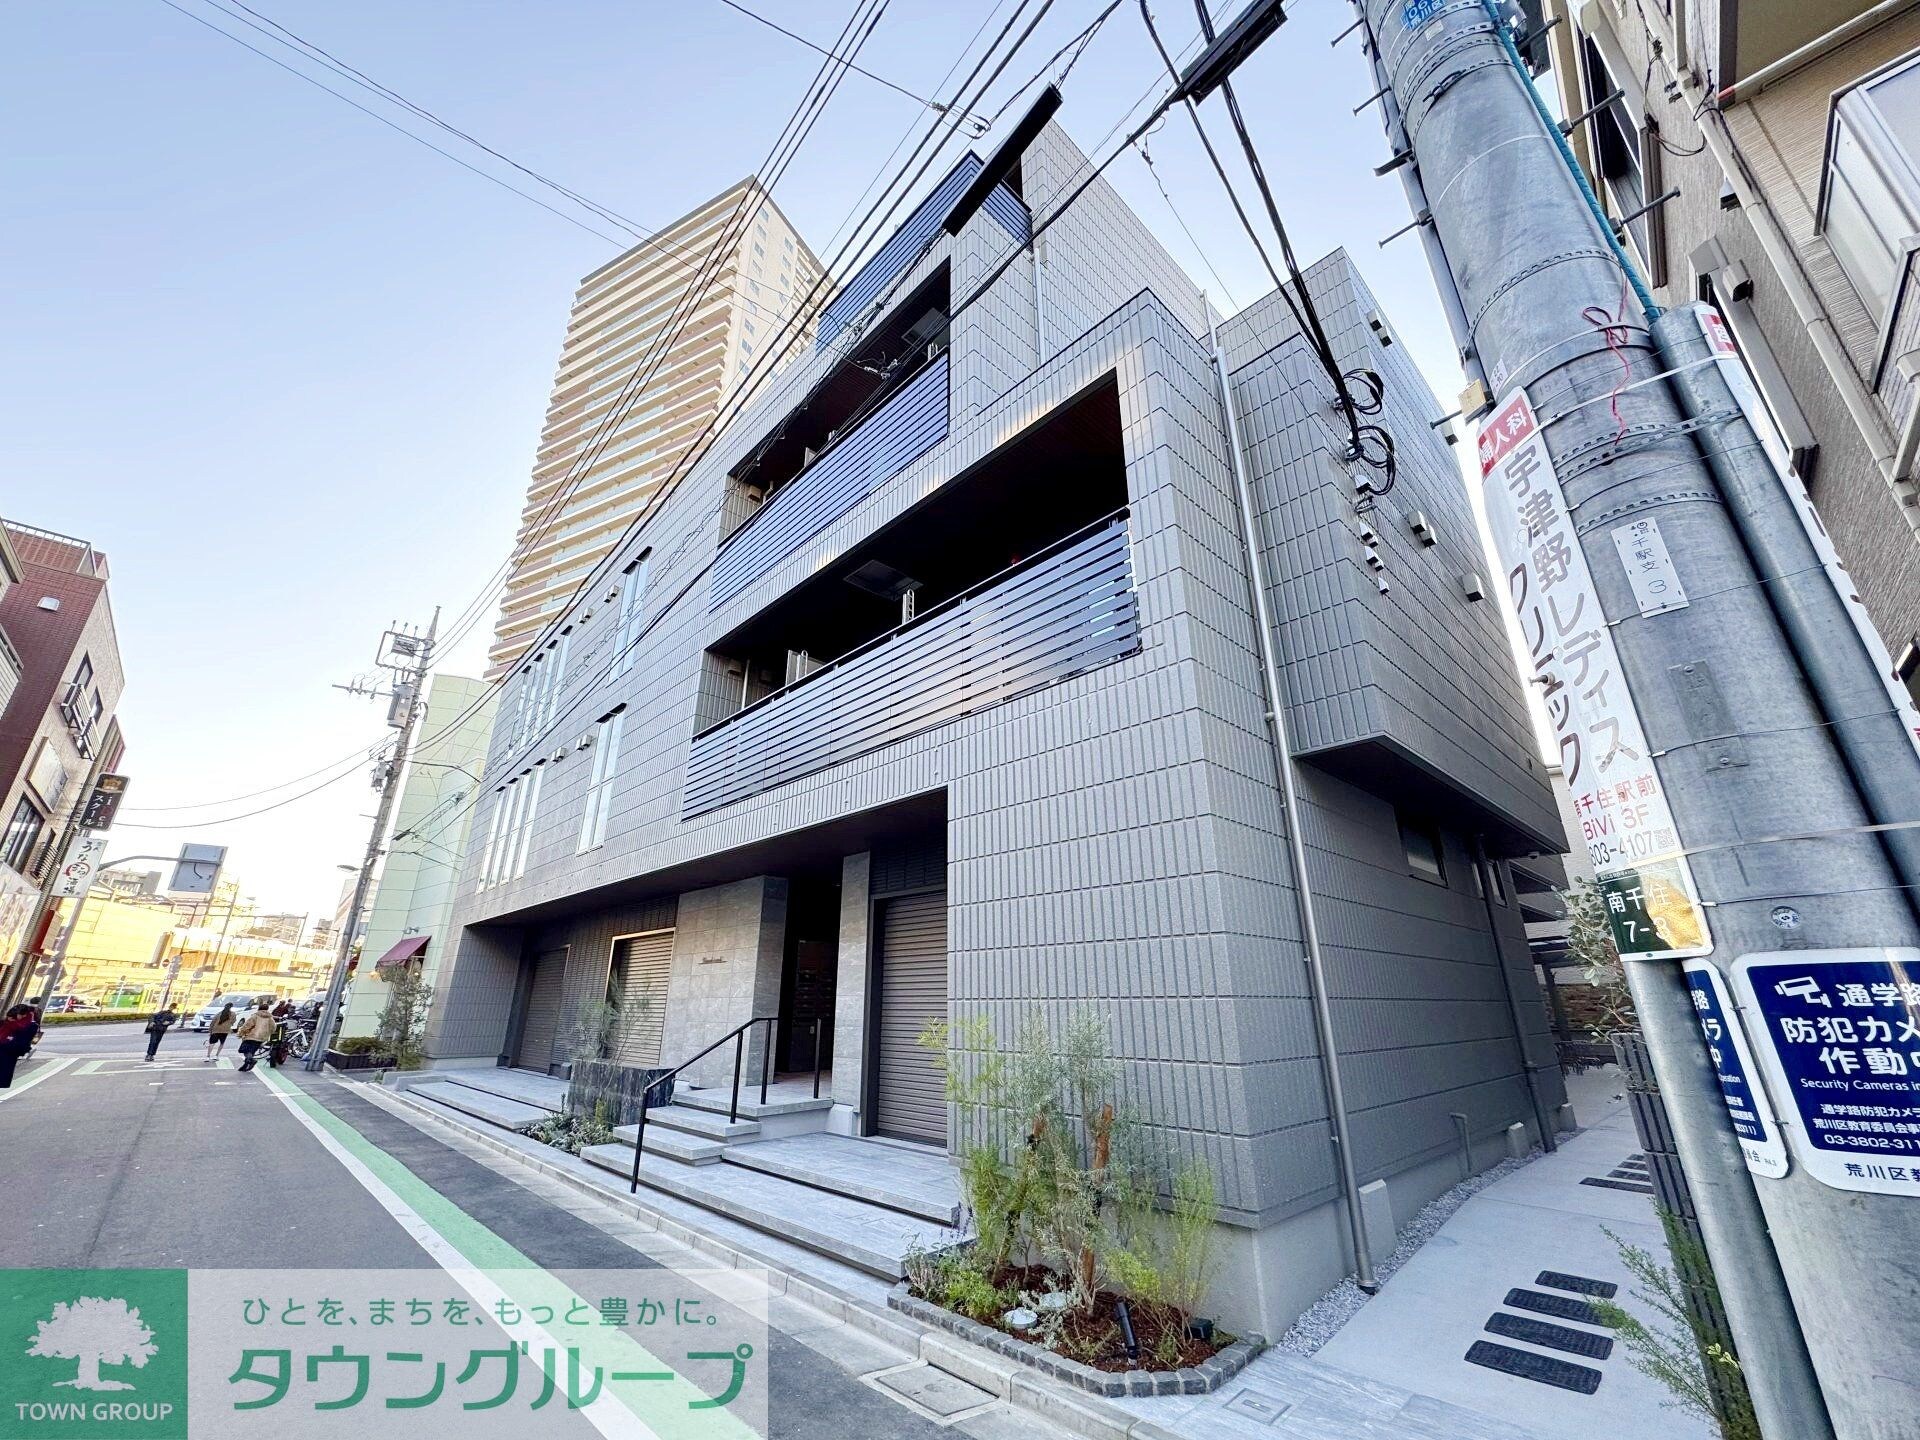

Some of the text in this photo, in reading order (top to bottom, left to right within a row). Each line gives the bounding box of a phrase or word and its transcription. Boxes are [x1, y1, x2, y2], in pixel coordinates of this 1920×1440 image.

[1504, 445, 1640, 774] 宇津野レディス
[1510, 562, 1582, 787] クリニック
[84, 794, 104, 826] スクール
[1583, 803, 1650, 841] BiVi 3F
[1606, 884, 1673, 914] 南千住
[1835, 982, 1920, 1007] 通学路
[1780, 1016, 1920, 1043] 防犯カメ
[1801, 1078, 1849, 1092] Security
[1853, 1080, 1909, 1091] Cameras
